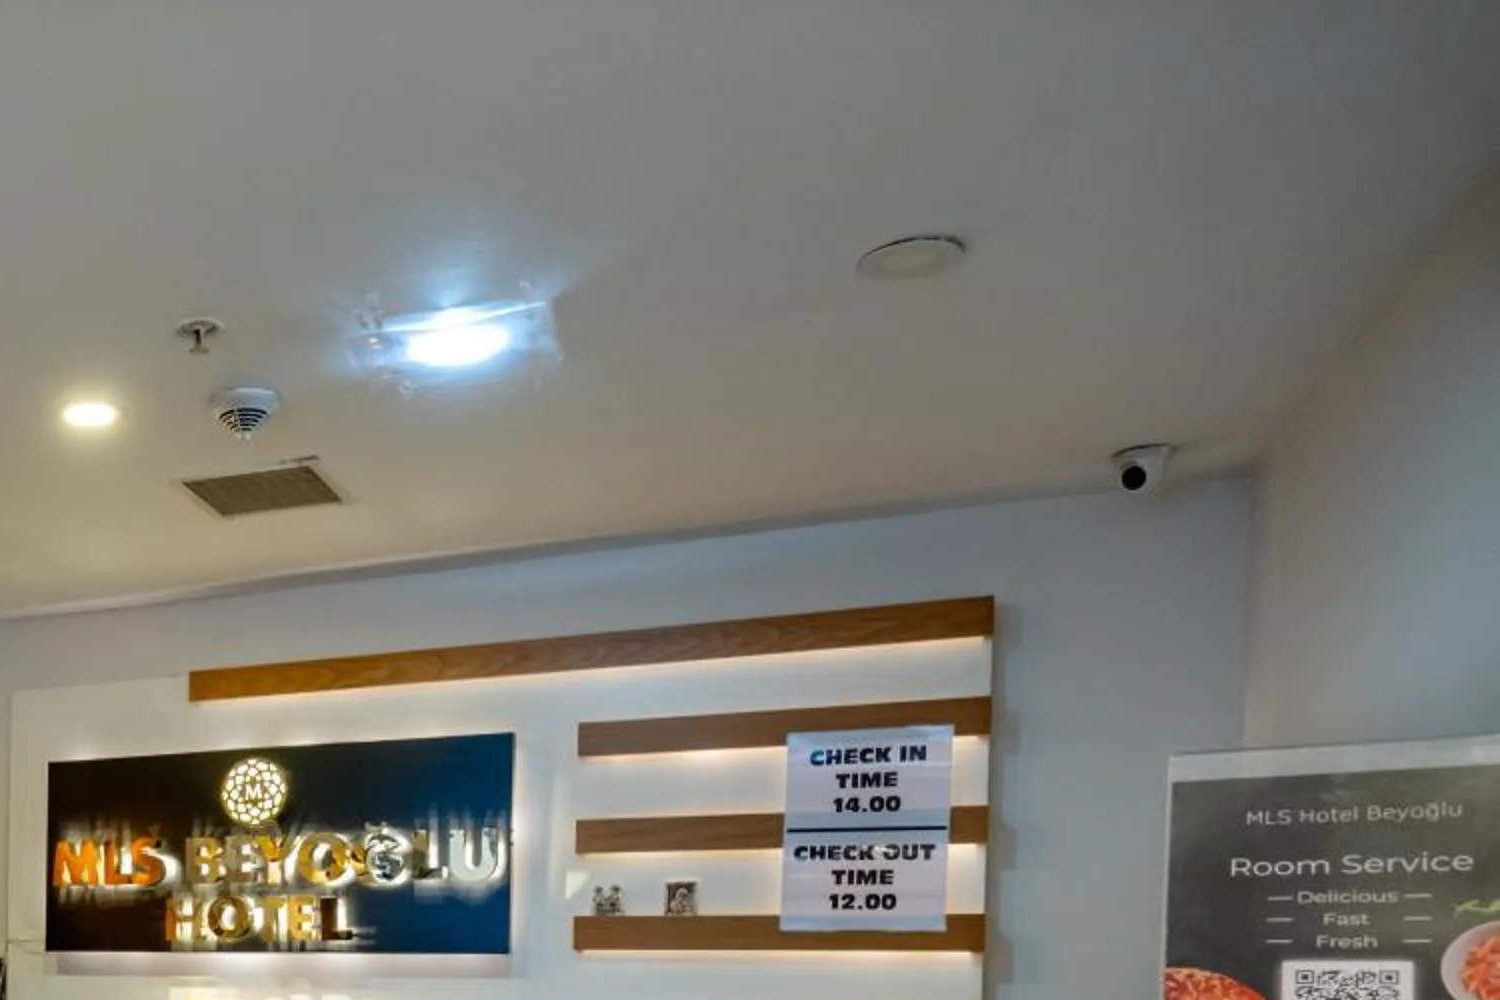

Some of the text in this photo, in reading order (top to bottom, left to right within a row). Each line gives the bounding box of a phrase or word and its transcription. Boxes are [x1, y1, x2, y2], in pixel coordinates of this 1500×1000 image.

[809, 744, 928, 766] CHECK IN
[835, 771, 899, 789] TIME
[832, 795, 902, 813] 14.00
[1246, 801, 1463, 826] MLS Hotel Beyoğlu
[53, 836, 167, 886] MLS
[792, 842, 937, 862] CHECK OUT
[1230, 851, 1475, 877] Room Service
[830, 869, 895, 887] TIME
[827, 893, 898, 911] 12.00
[1297, 890, 1399, 904] Delicious
[165, 894, 354, 944] HOTEL
[1323, 912, 1370, 926] Fast
[1316, 934, 1379, 949] Fresh
